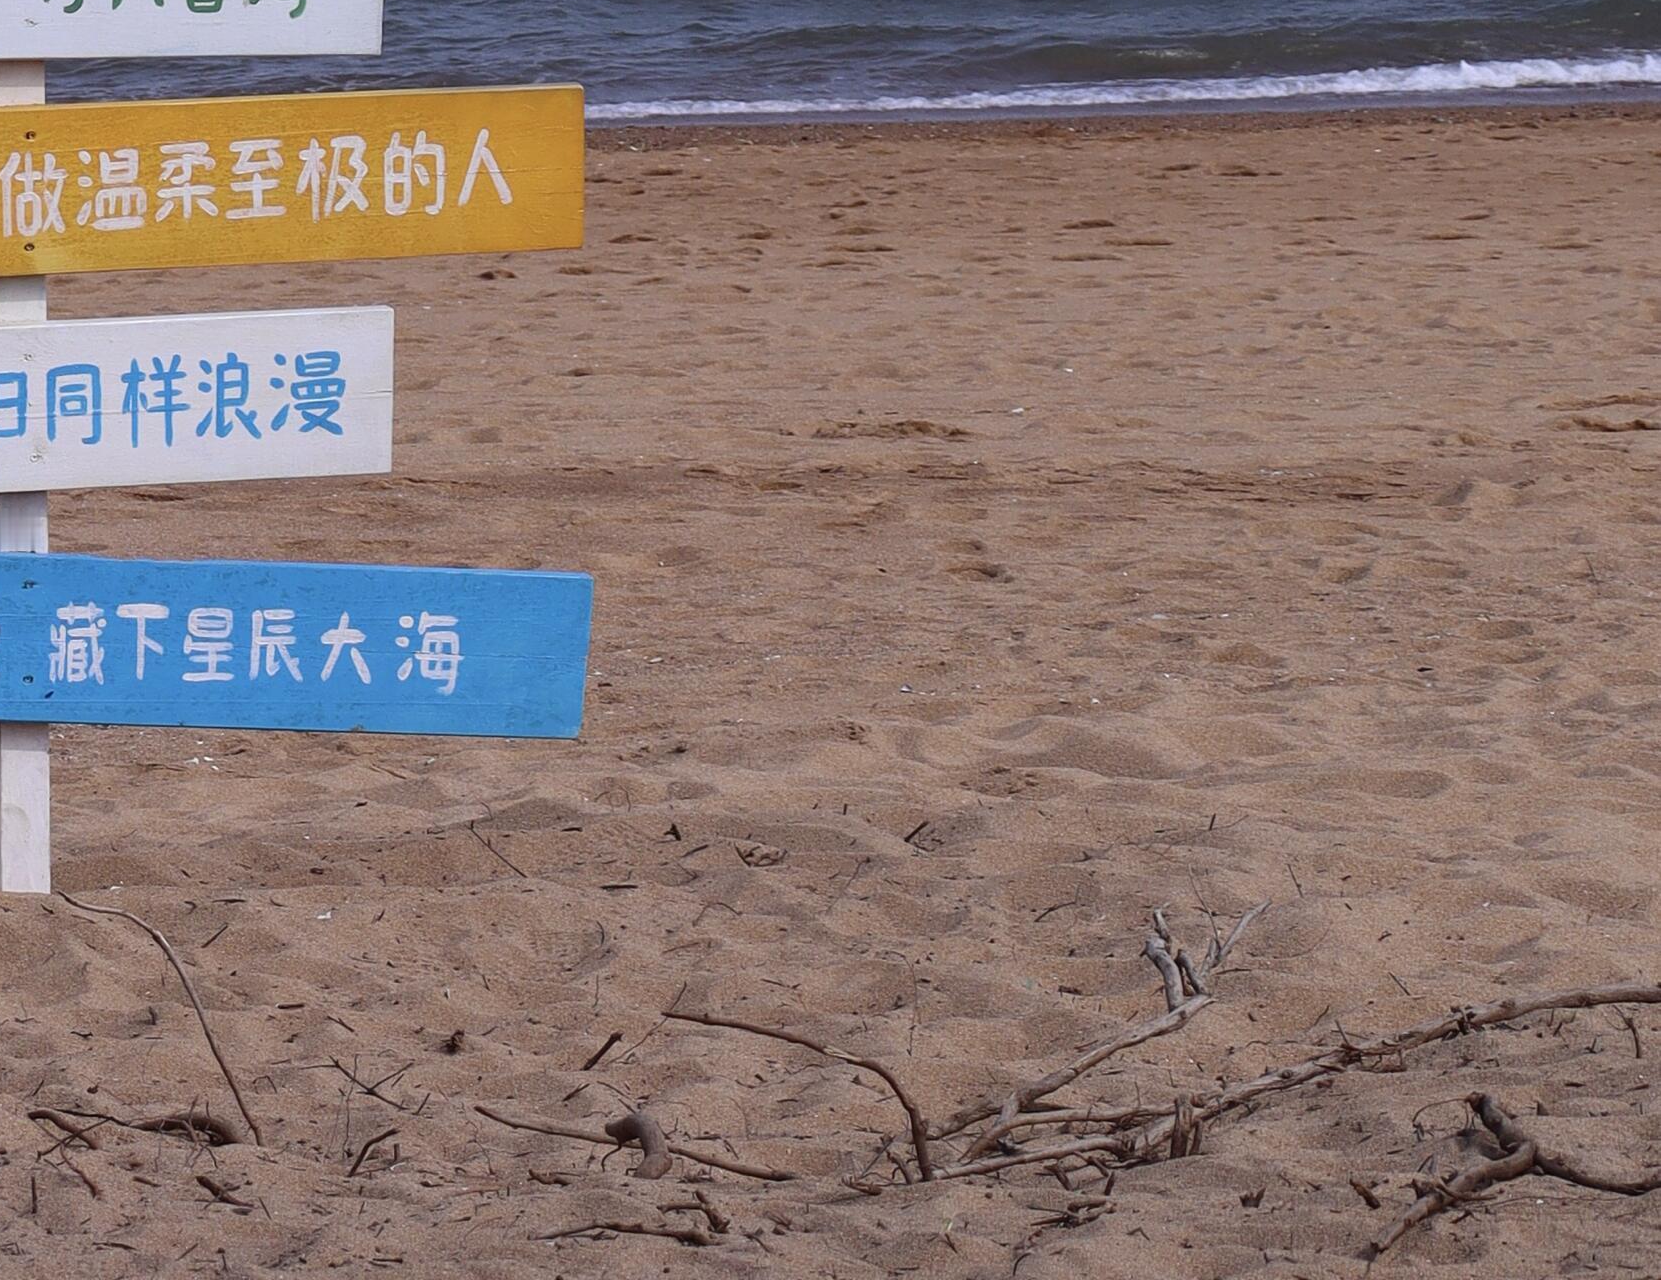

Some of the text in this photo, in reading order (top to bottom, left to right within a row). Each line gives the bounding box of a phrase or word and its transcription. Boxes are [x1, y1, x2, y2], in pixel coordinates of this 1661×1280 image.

[47, 601, 465, 695] 藏下星辰大海
